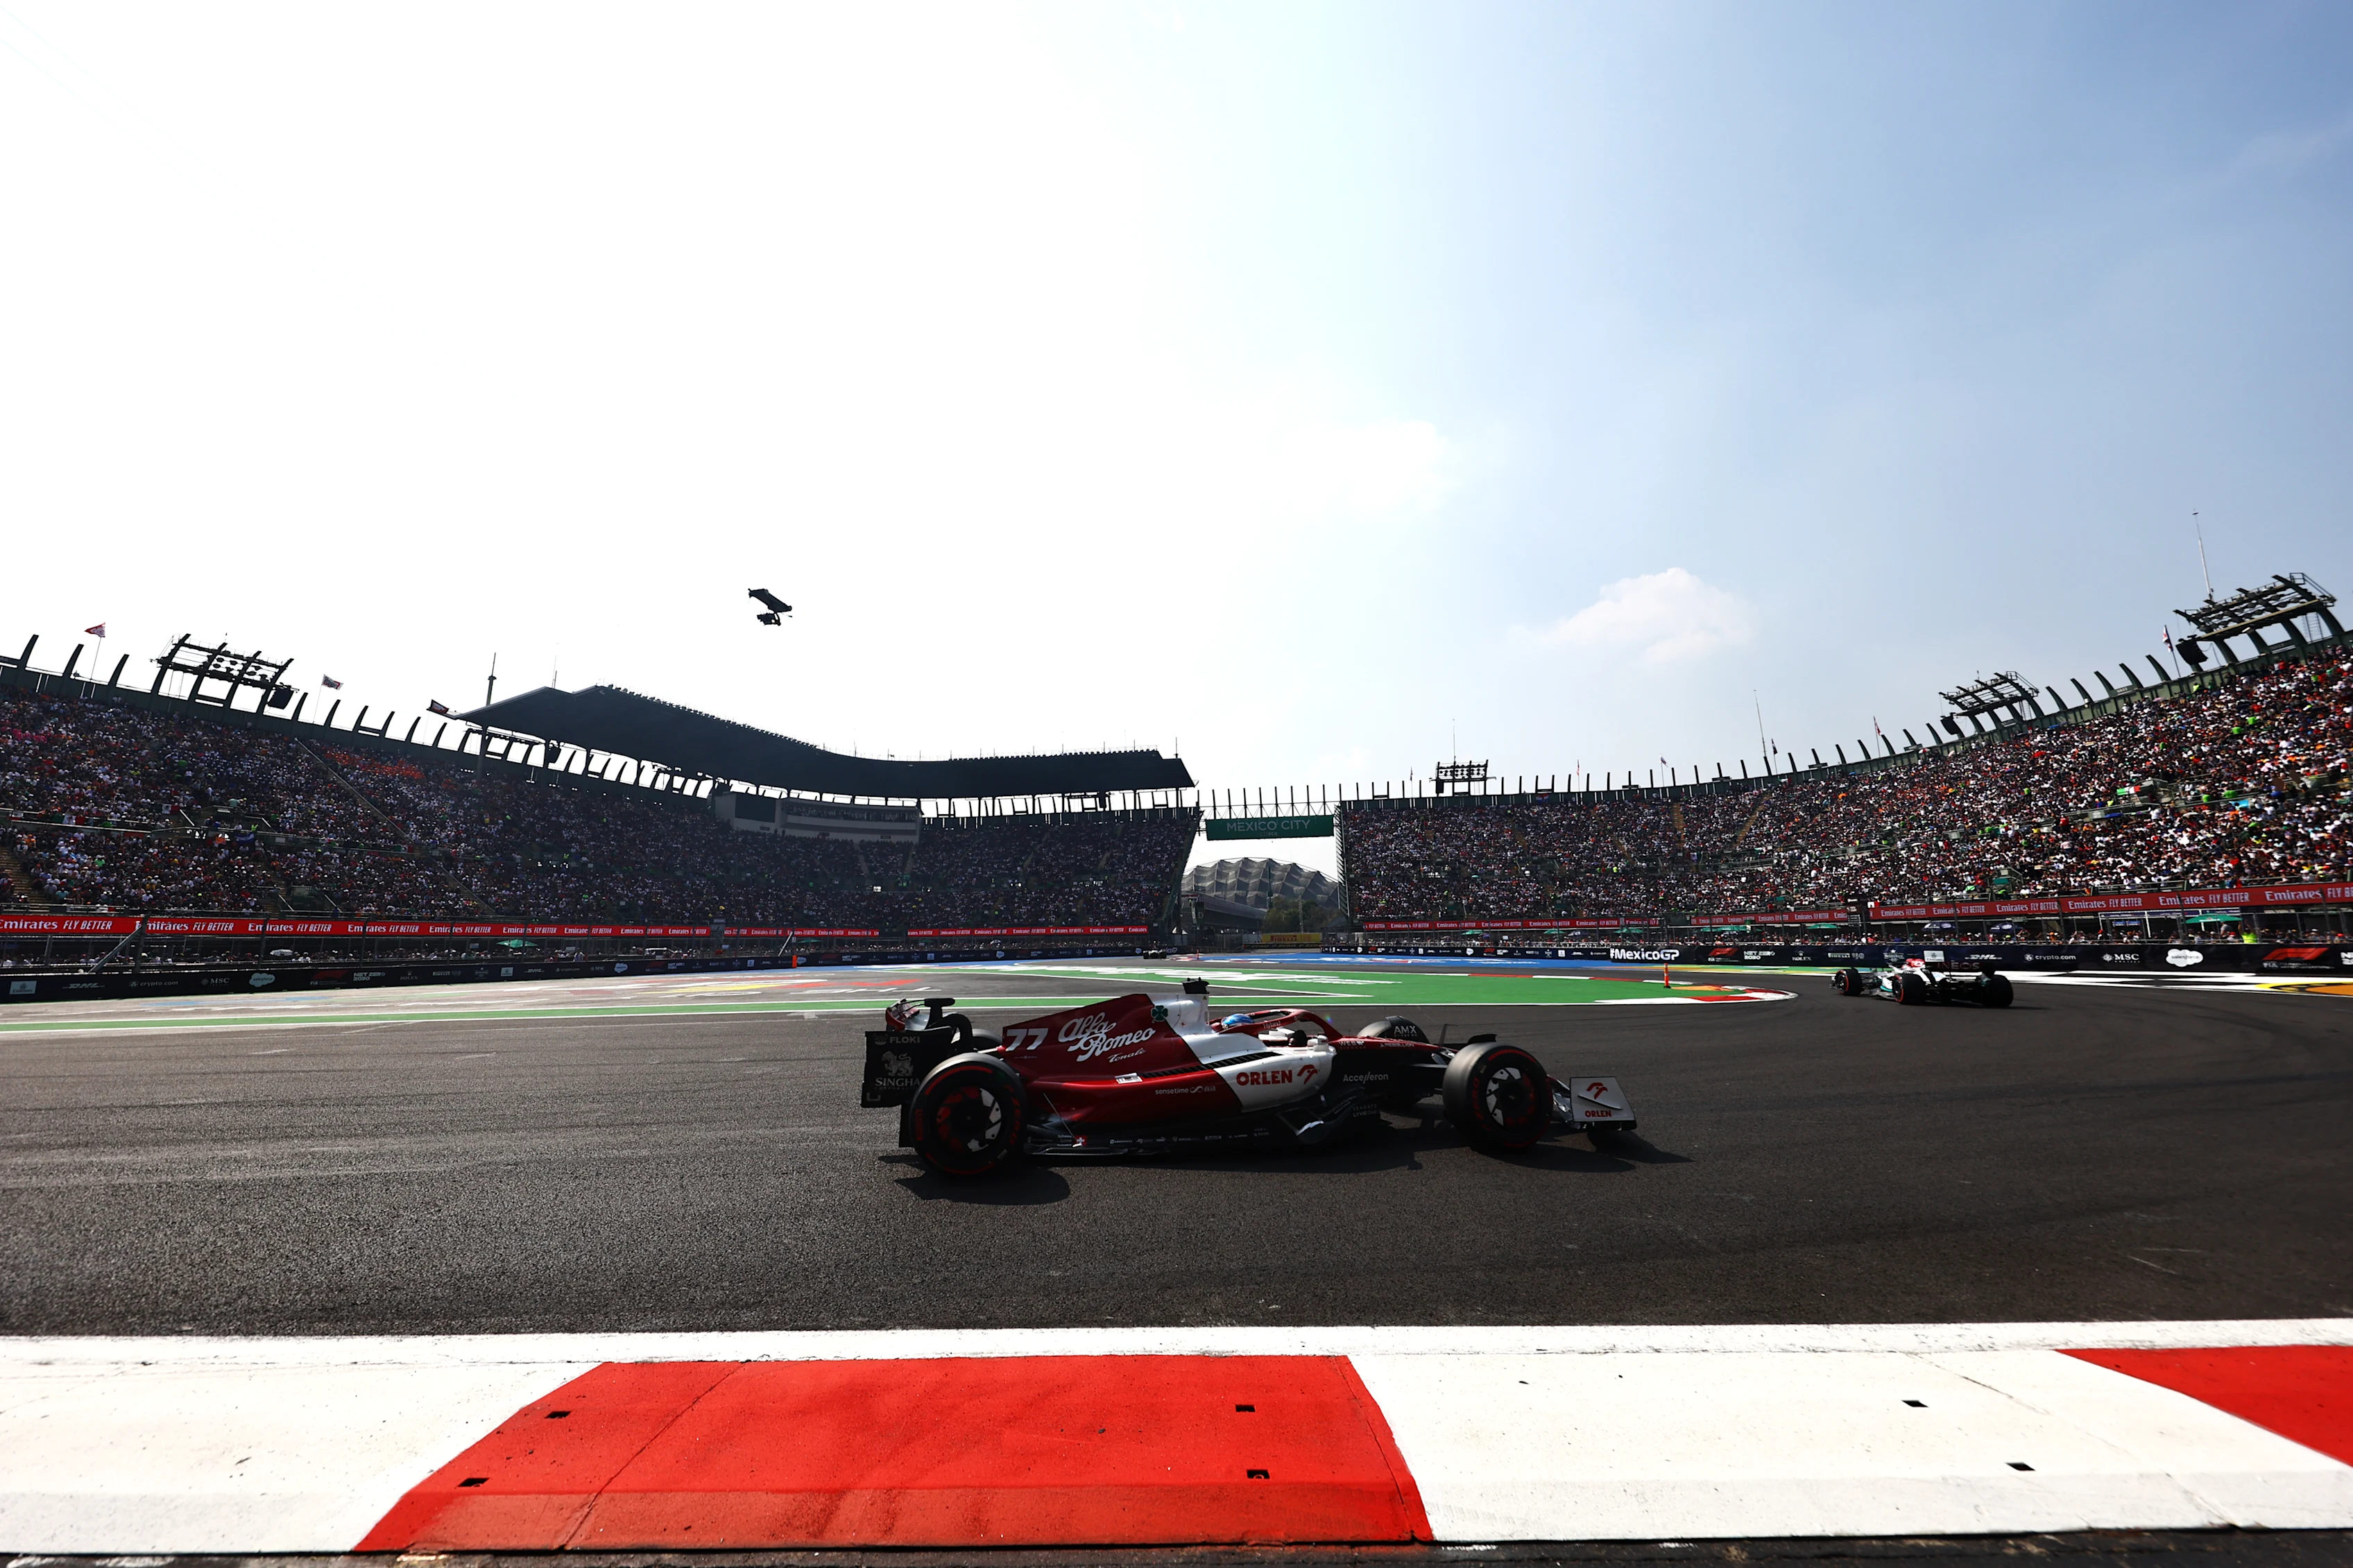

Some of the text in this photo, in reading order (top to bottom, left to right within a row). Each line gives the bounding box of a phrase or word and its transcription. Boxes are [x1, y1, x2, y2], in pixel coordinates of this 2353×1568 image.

[1226, 819, 1311, 832] MEXICO CITY
[2209, 894, 2221, 904] FLY
[2222, 893, 2250, 904] BETTER
[2264, 890, 2322, 902] Emirates
[2327, 888, 2343, 898] FLY
[1969, 905, 1985, 913] BETTER
[1996, 904, 2029, 913] Emirates
[2039, 902, 2059, 911] BETTER
[2068, 898, 2143, 910] Emirates FLY BETTER
[63, 920, 80, 930] FLY
[80, 920, 113, 931] BETTER
[192, 922, 207, 931] FLY
[207, 922, 234, 931] BETTER
[296, 924, 309, 932] FLY
[309, 924, 332, 932] BETTER
[348, 924, 387, 933] Emrates
[1610, 948, 1680, 960] #MexicoGP
[1057, 1011, 1117, 1042] Alfa
[1394, 1025, 1417, 1034] AMX
[1005, 1028, 1049, 1052] 77
[1067, 1027, 1156, 1062] Romeo
[1107, 1047, 1147, 1063] Tonale
[875, 1077, 921, 1087] SINGHA
[1236, 1070, 1293, 1086] ORLEN
[1154, 1087, 1189, 1095] sensetime
[1585, 1110, 1612, 1118] ORLEN
